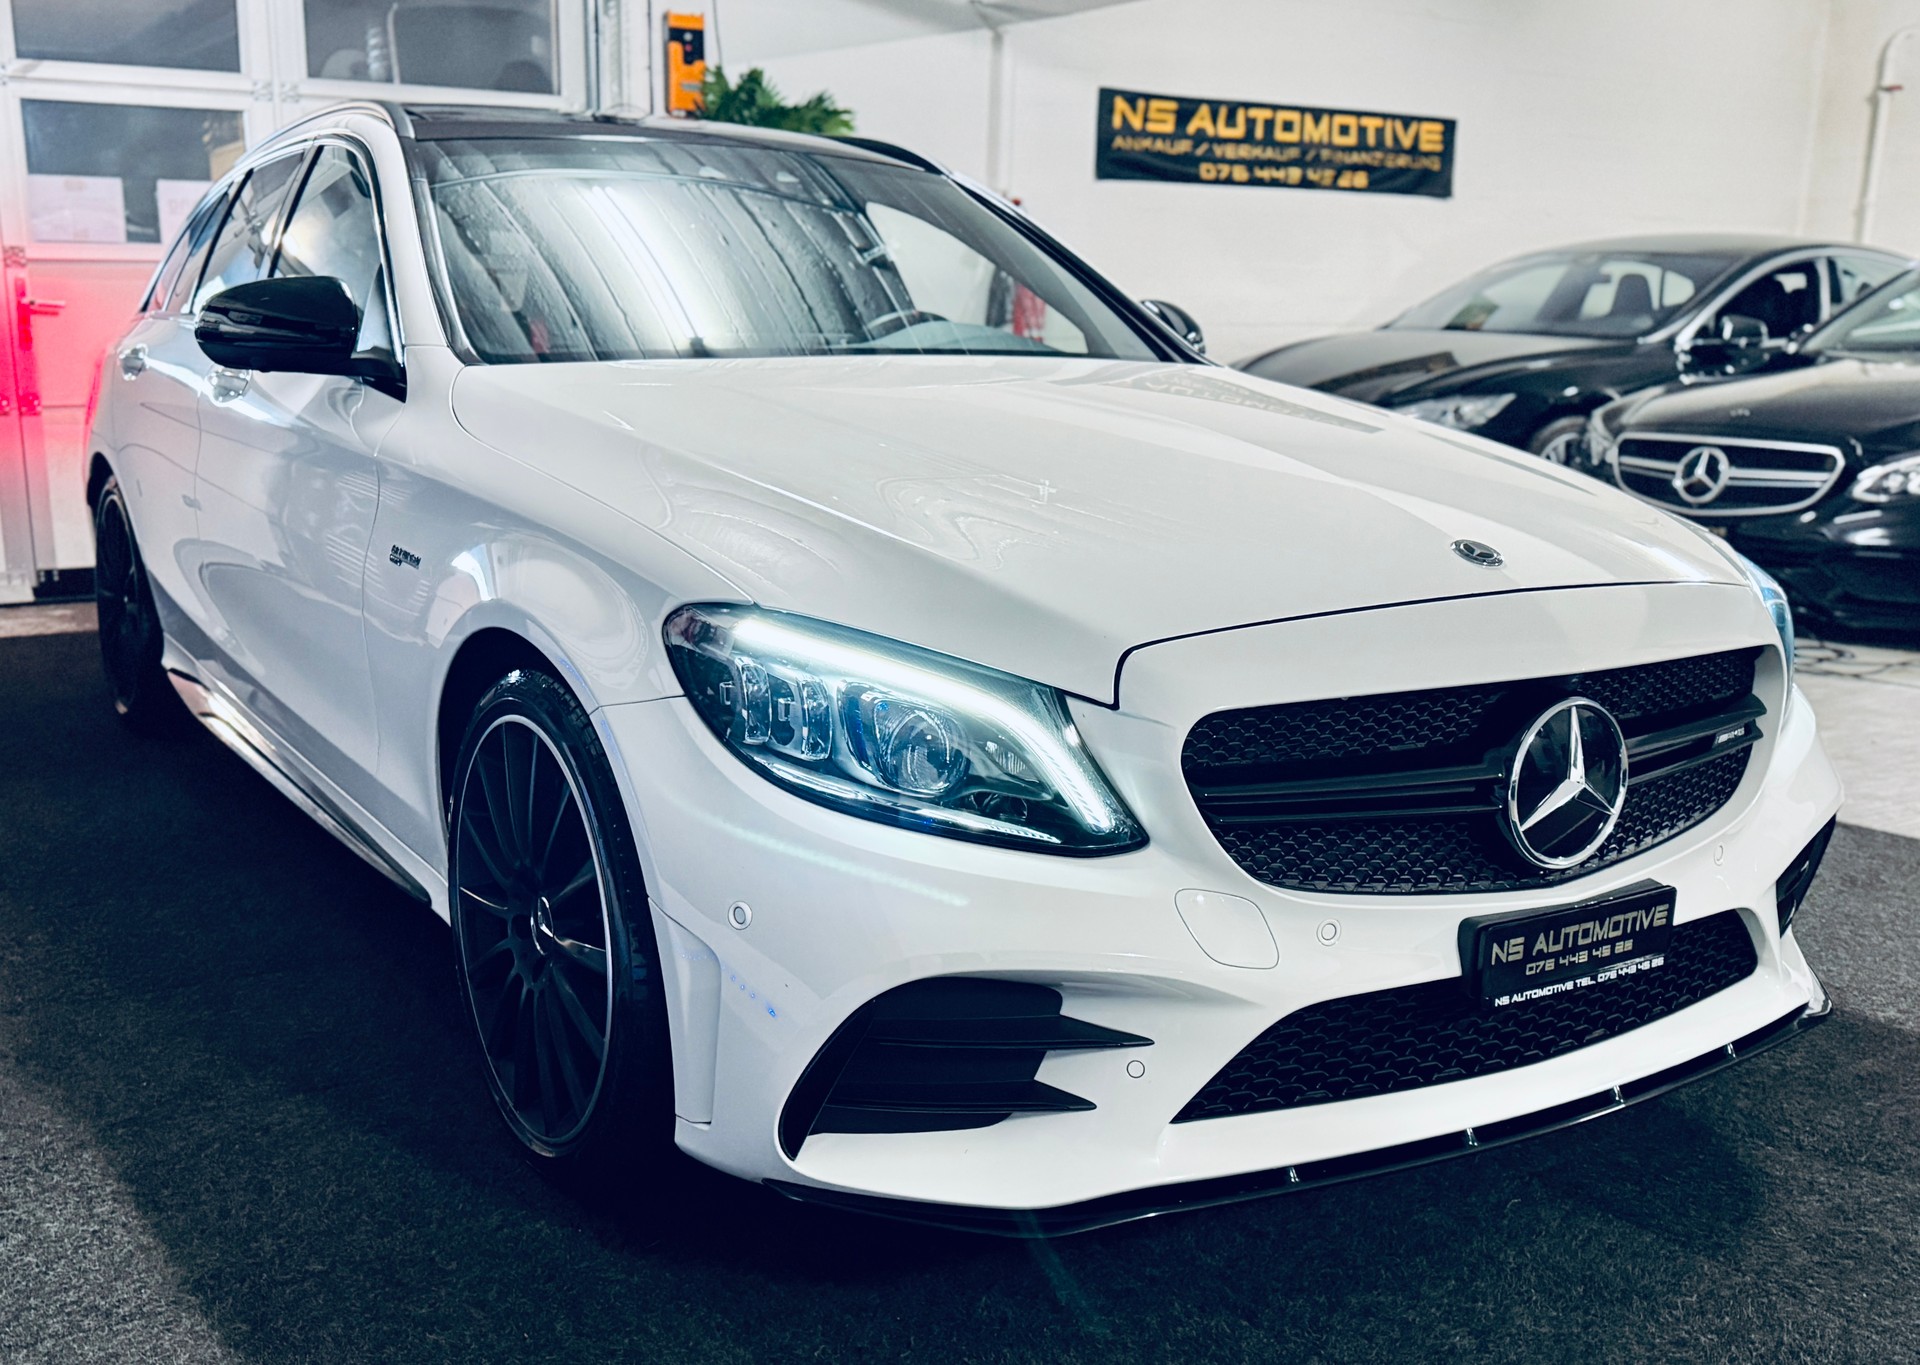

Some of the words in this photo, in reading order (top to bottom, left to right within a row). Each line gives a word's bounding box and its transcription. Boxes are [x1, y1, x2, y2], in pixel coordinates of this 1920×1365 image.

[1112, 95, 1179, 134] NS
[1186, 103, 1444, 154] AUTOMOTIVE
[1491, 936, 1525, 966] NS
[1532, 903, 1670, 956] AUTOMOTIVE
[1494, 995, 1510, 1007] NS
[1511, 980, 1574, 1003] AUTOMOTIVE
